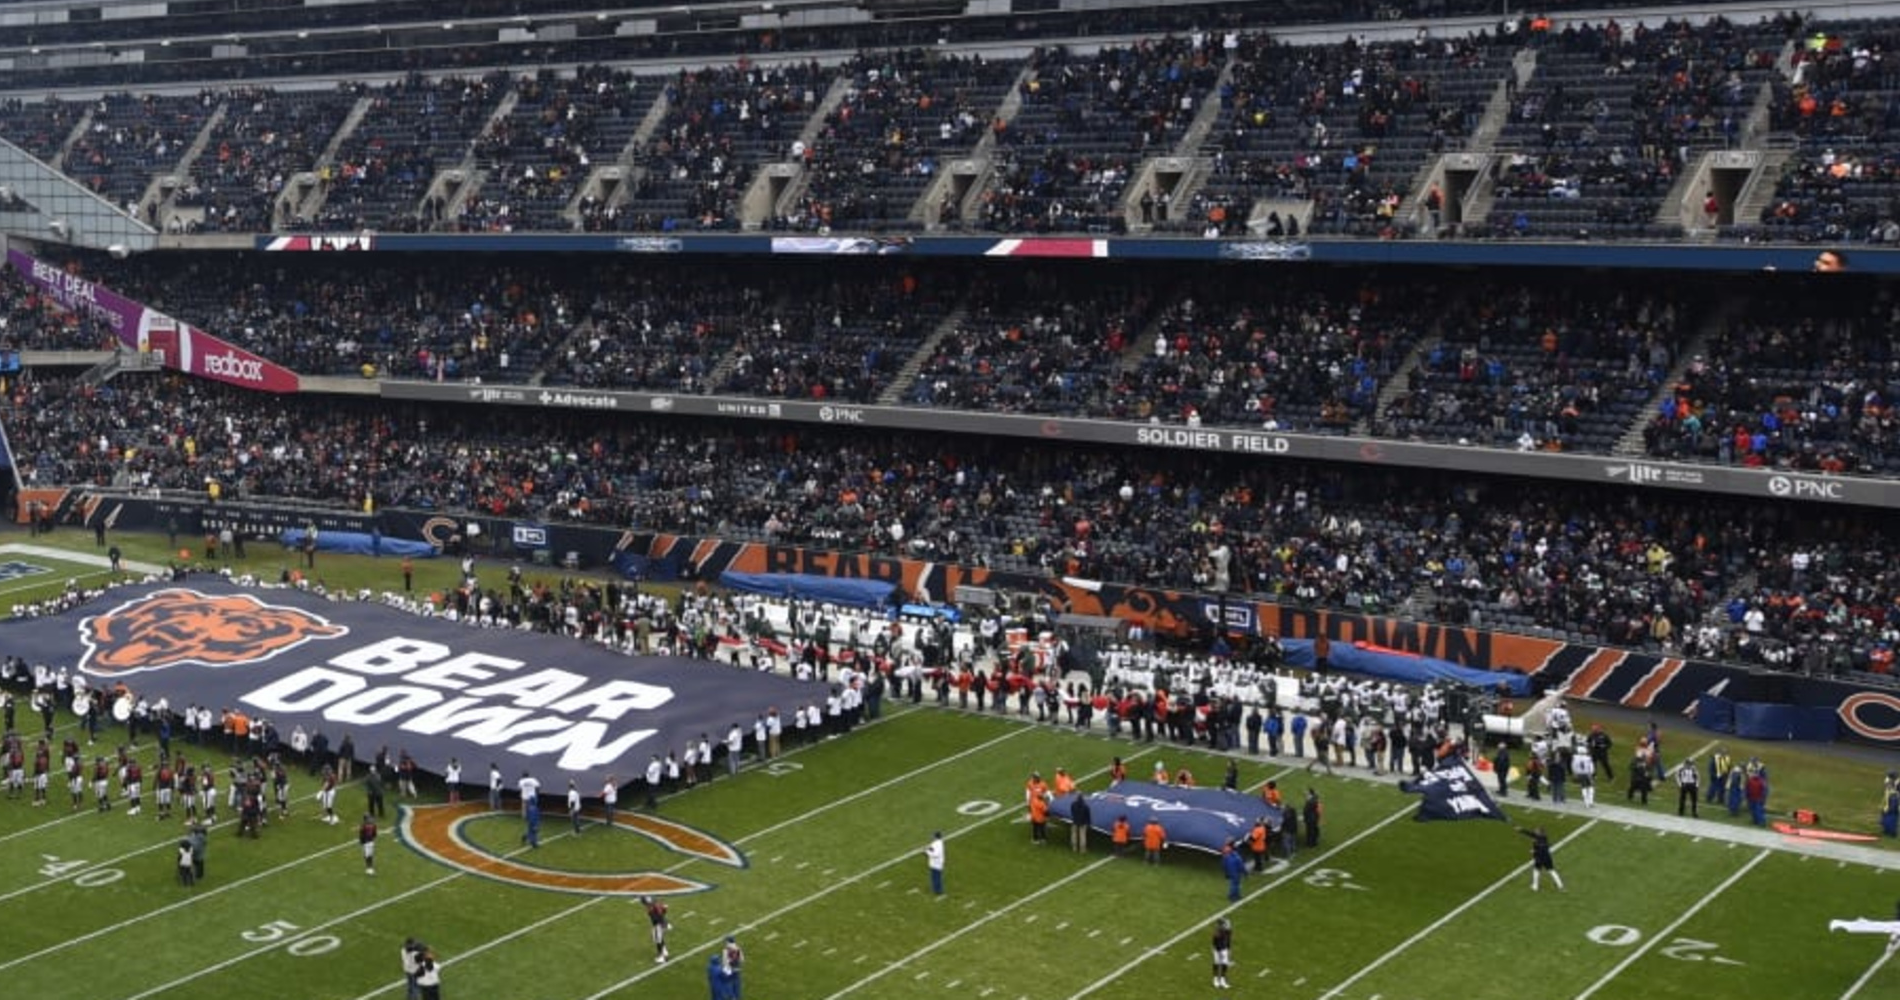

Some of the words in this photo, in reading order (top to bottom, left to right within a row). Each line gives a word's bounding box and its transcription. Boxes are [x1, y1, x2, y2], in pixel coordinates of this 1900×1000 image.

[32, 260, 63, 285] BEST
[65, 274, 97, 302] DEAL
[204, 350, 263, 382] redbox
[553, 393, 617, 408] Advocate
[717, 403, 766, 415] UNITED
[835, 411, 864, 422] PNC
[1136, 427, 1220, 449] SOLDIER
[1231, 434, 1290, 454] FIELD
[1796, 480, 1843, 498] PNC
[326, 635, 676, 721] BEAR
[236, 665, 660, 772] DOWN
[38, 854, 126, 887] 40
[241, 919, 342, 957] 50
